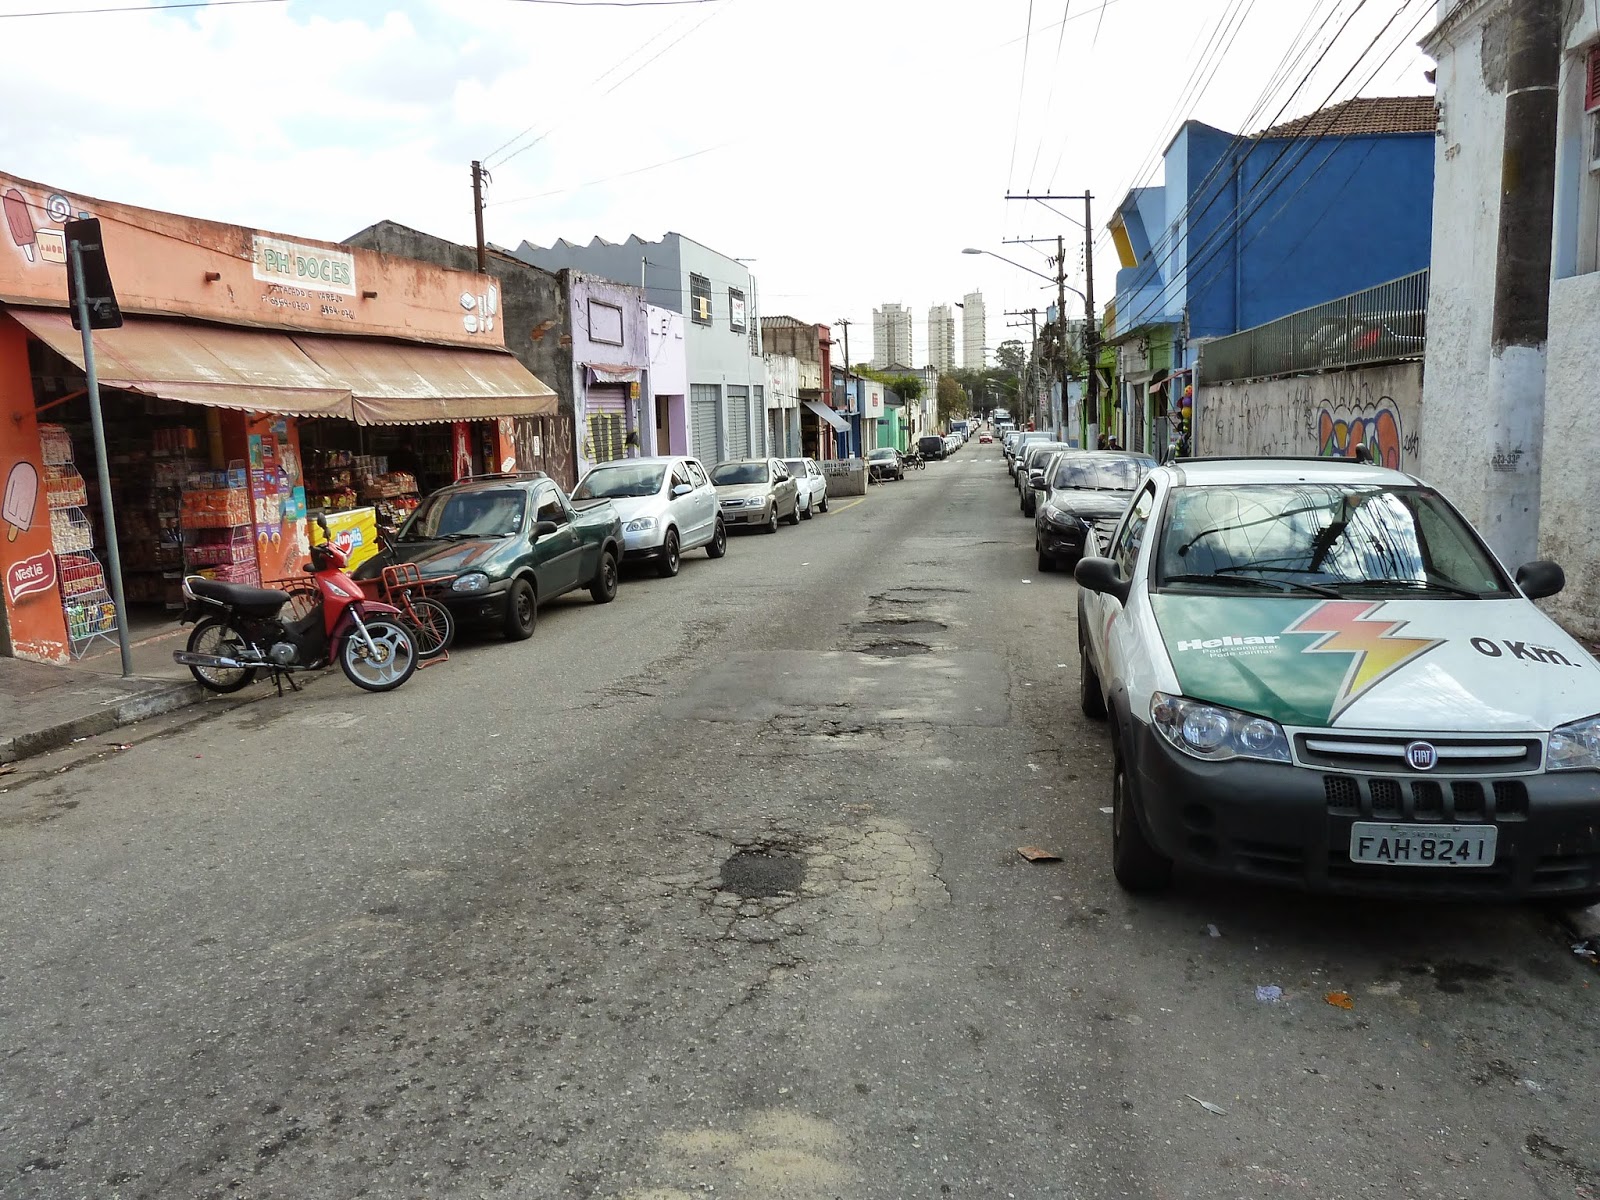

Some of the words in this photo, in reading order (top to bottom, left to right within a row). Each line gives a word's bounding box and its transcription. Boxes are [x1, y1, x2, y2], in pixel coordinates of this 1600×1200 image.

[40, 243, 63, 255] AMOR
[264, 249, 290, 273] PH
[296, 257, 350, 285] DOCES
[1177, 636, 1280, 651] Heliar
[1413, 750, 1430, 763] FIAT
